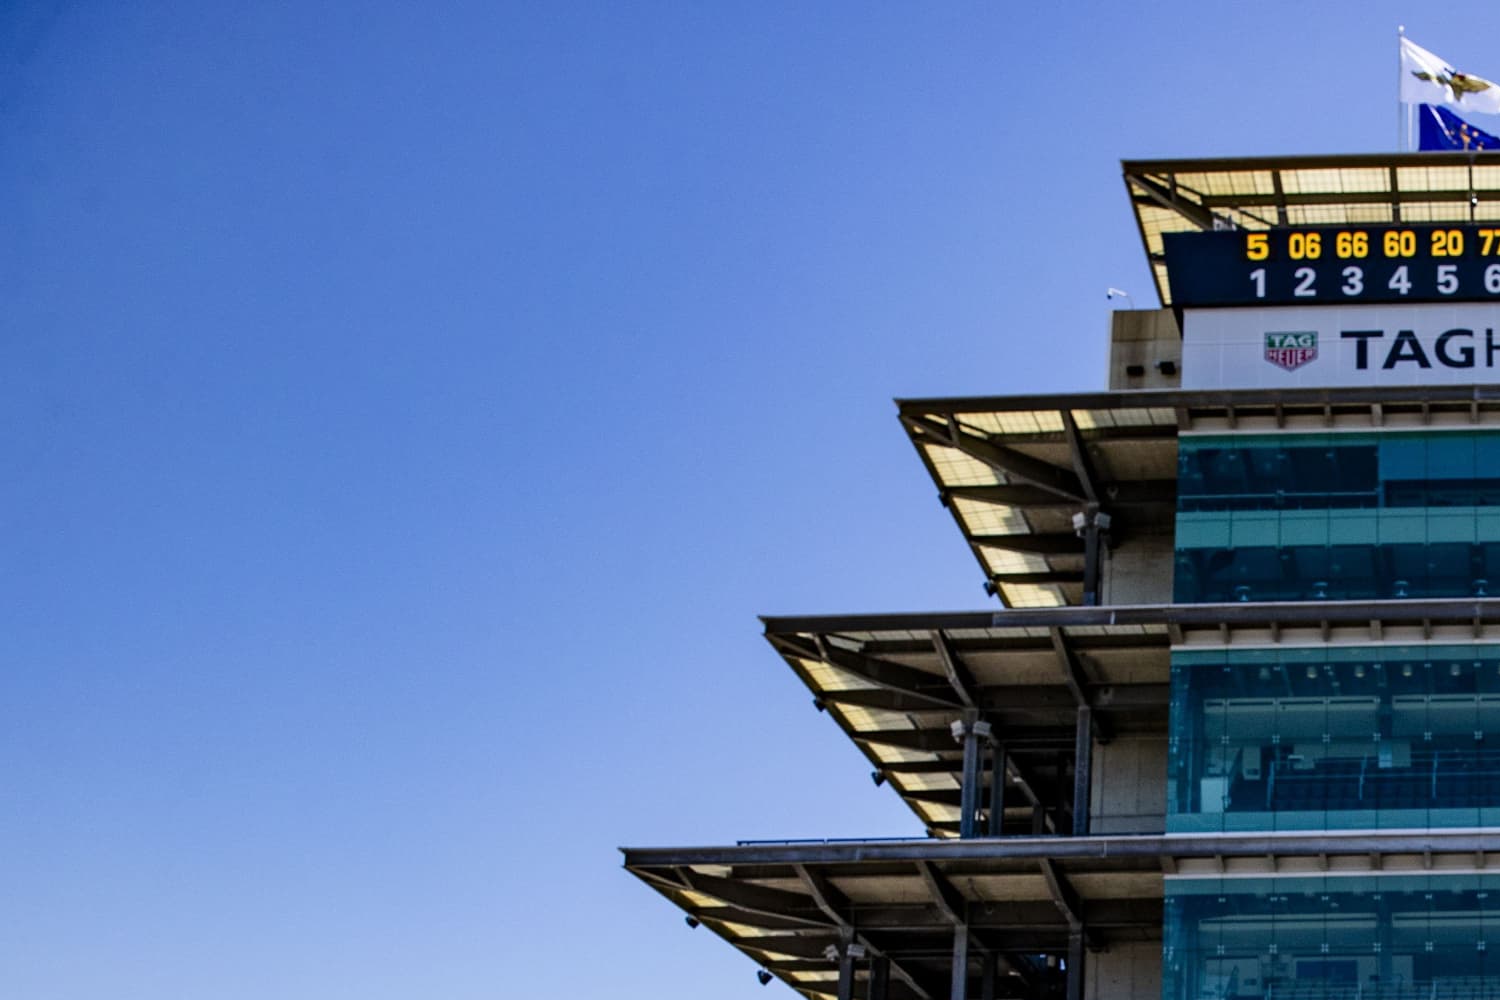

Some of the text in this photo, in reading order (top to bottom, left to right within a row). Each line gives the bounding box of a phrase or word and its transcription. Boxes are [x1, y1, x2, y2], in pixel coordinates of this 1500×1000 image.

[1247, 234, 1270, 260] 5
[1288, 233, 1321, 260] 06
[1336, 232, 1369, 259] 66
[1384, 231, 1416, 258] 60
[1431, 230, 1464, 257] 20
[1250, 268, 1266, 298] 1
[1294, 267, 1317, 297] 2
[1341, 266, 1364, 296] 3
[1388, 265, 1412, 295] 4
[1437, 264, 1459, 294] 5
[1271, 334, 1313, 348] TAG
[1268, 349, 1315, 367] HEUER
